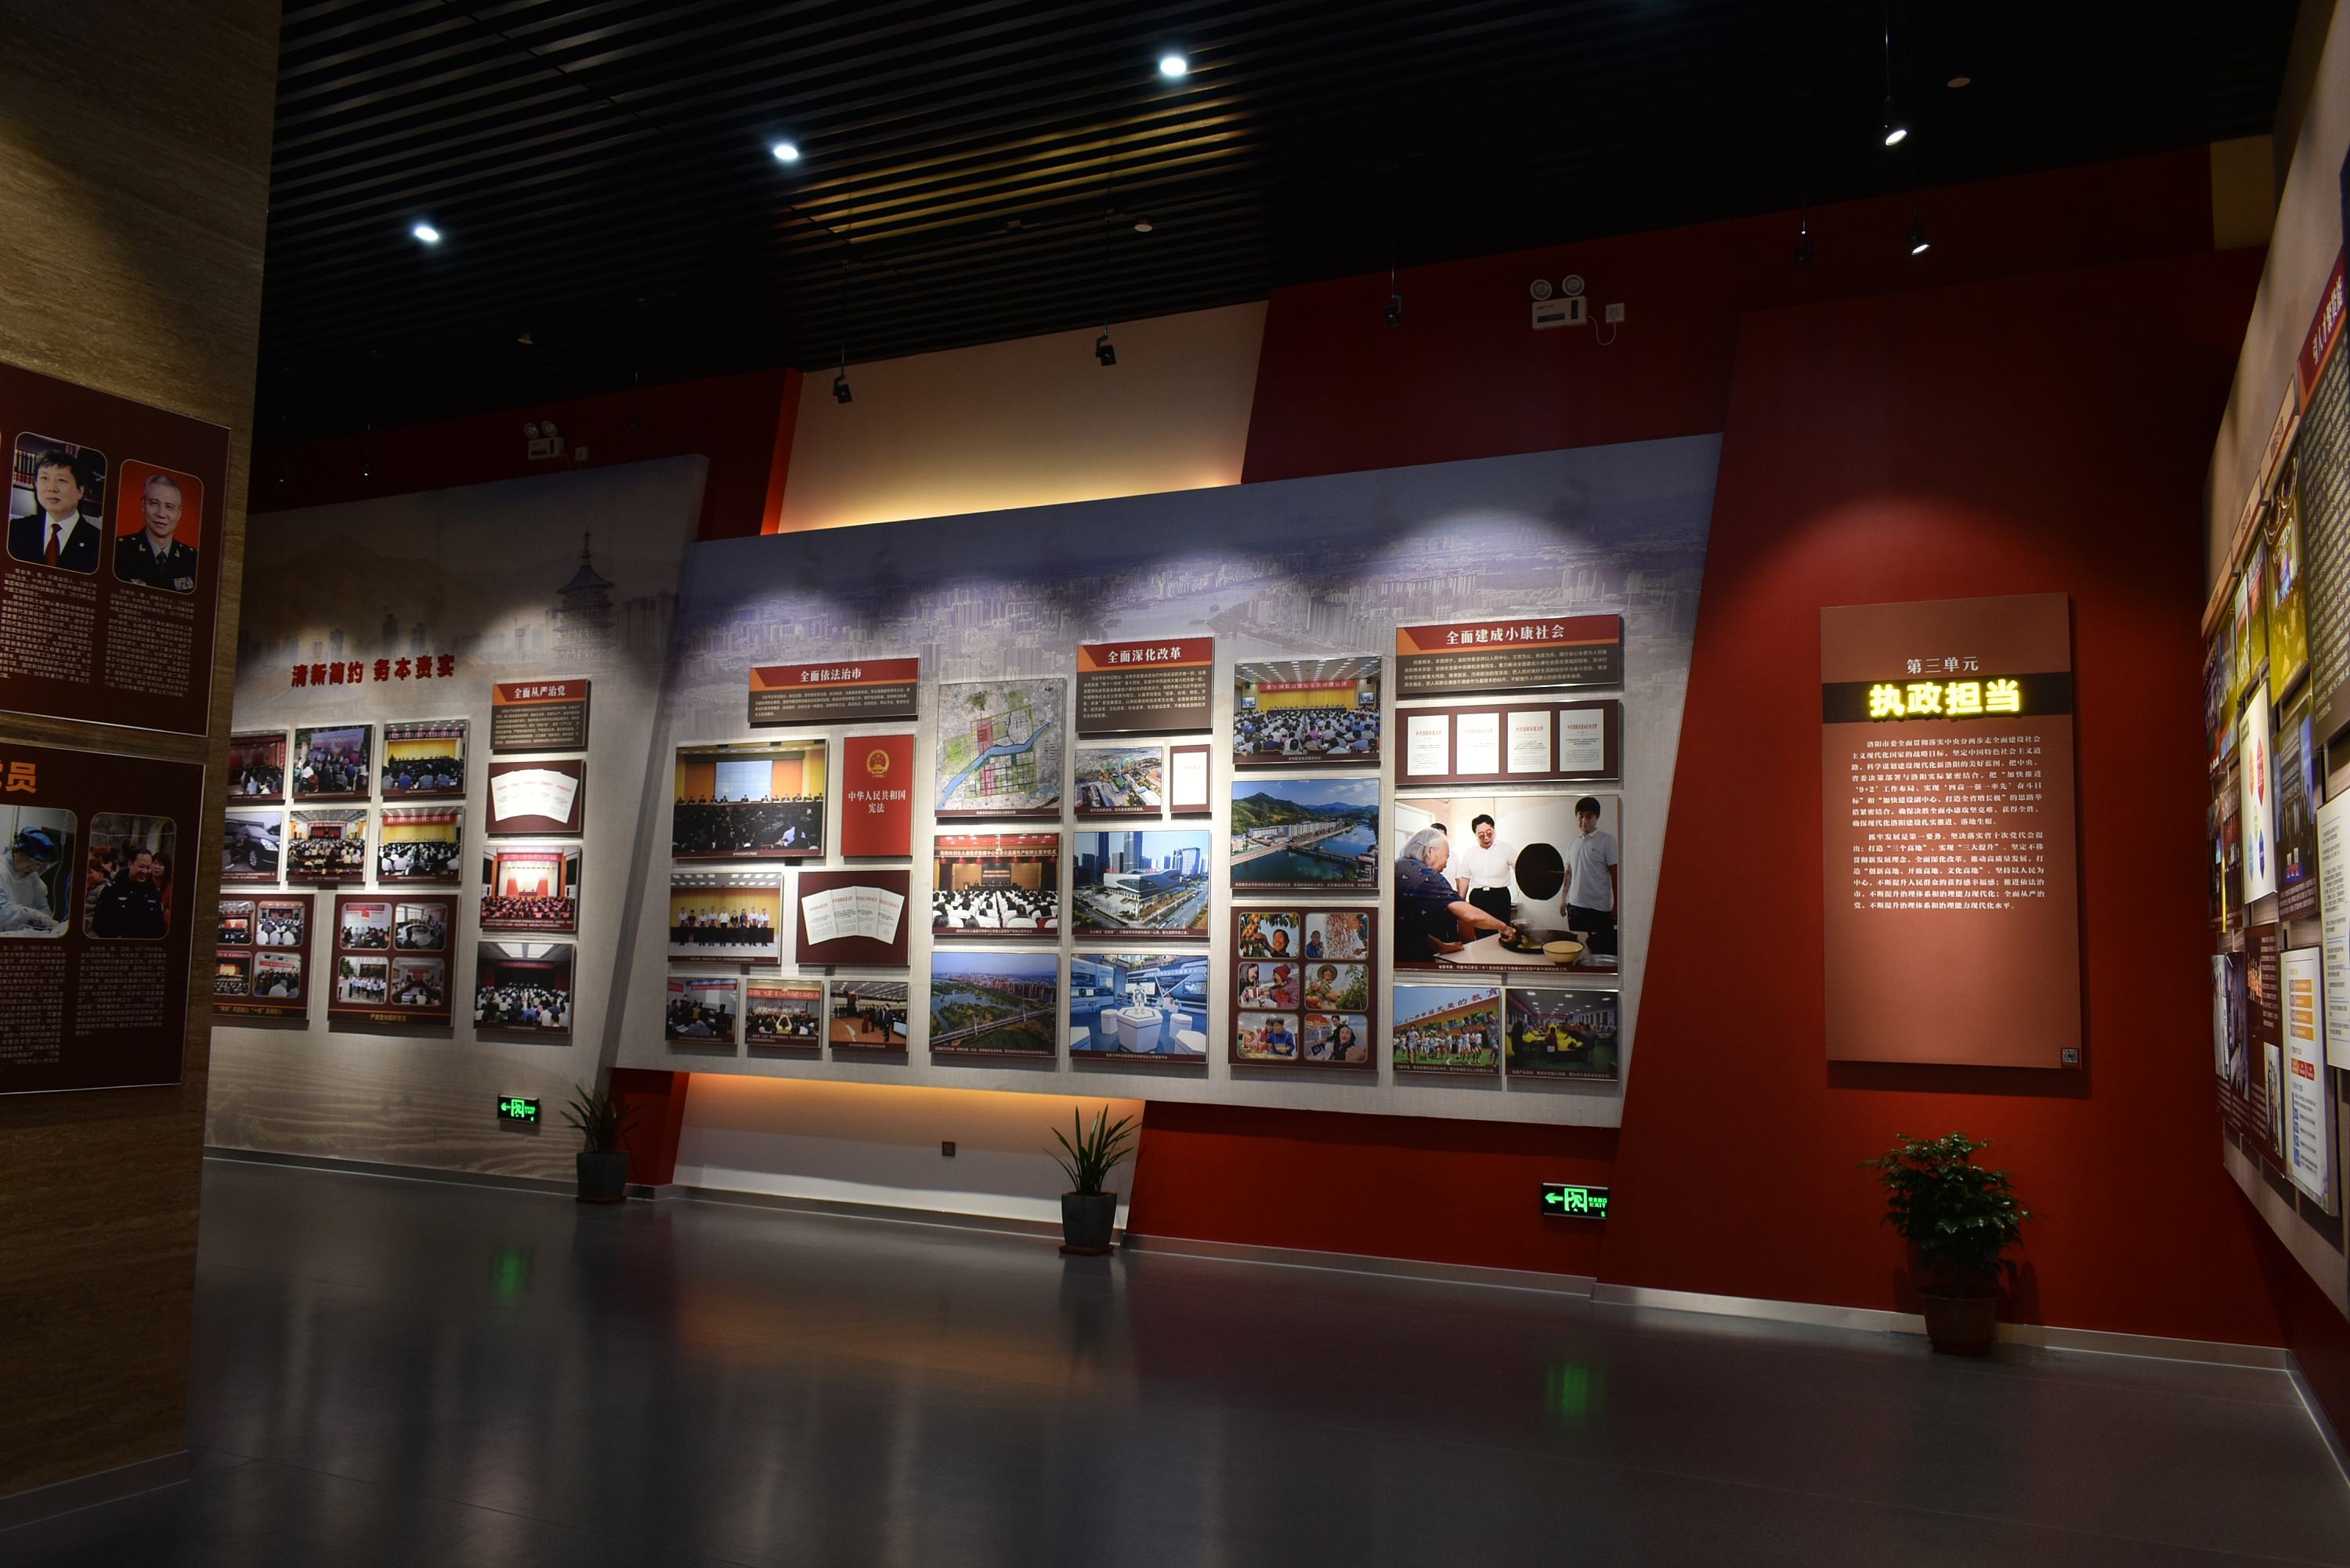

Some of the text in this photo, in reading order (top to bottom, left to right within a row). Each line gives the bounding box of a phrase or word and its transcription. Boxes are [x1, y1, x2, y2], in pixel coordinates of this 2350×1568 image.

[1446, 624, 1565, 645] 全面建成小康社会
[1108, 647, 1181, 663] 全面深化改革
[291, 661, 363, 687] 清新简约
[1906, 656, 1979, 675] 第三单元
[800, 667, 862, 682] 全面依法治市
[514, 685, 566, 699] 全面从严治党
[1869, 678, 2022, 718] 执政担当
[0, 760, 37, 794] 员
[848, 789, 906, 802] 中华人民共和国
[868, 803, 885, 814] 宪法
